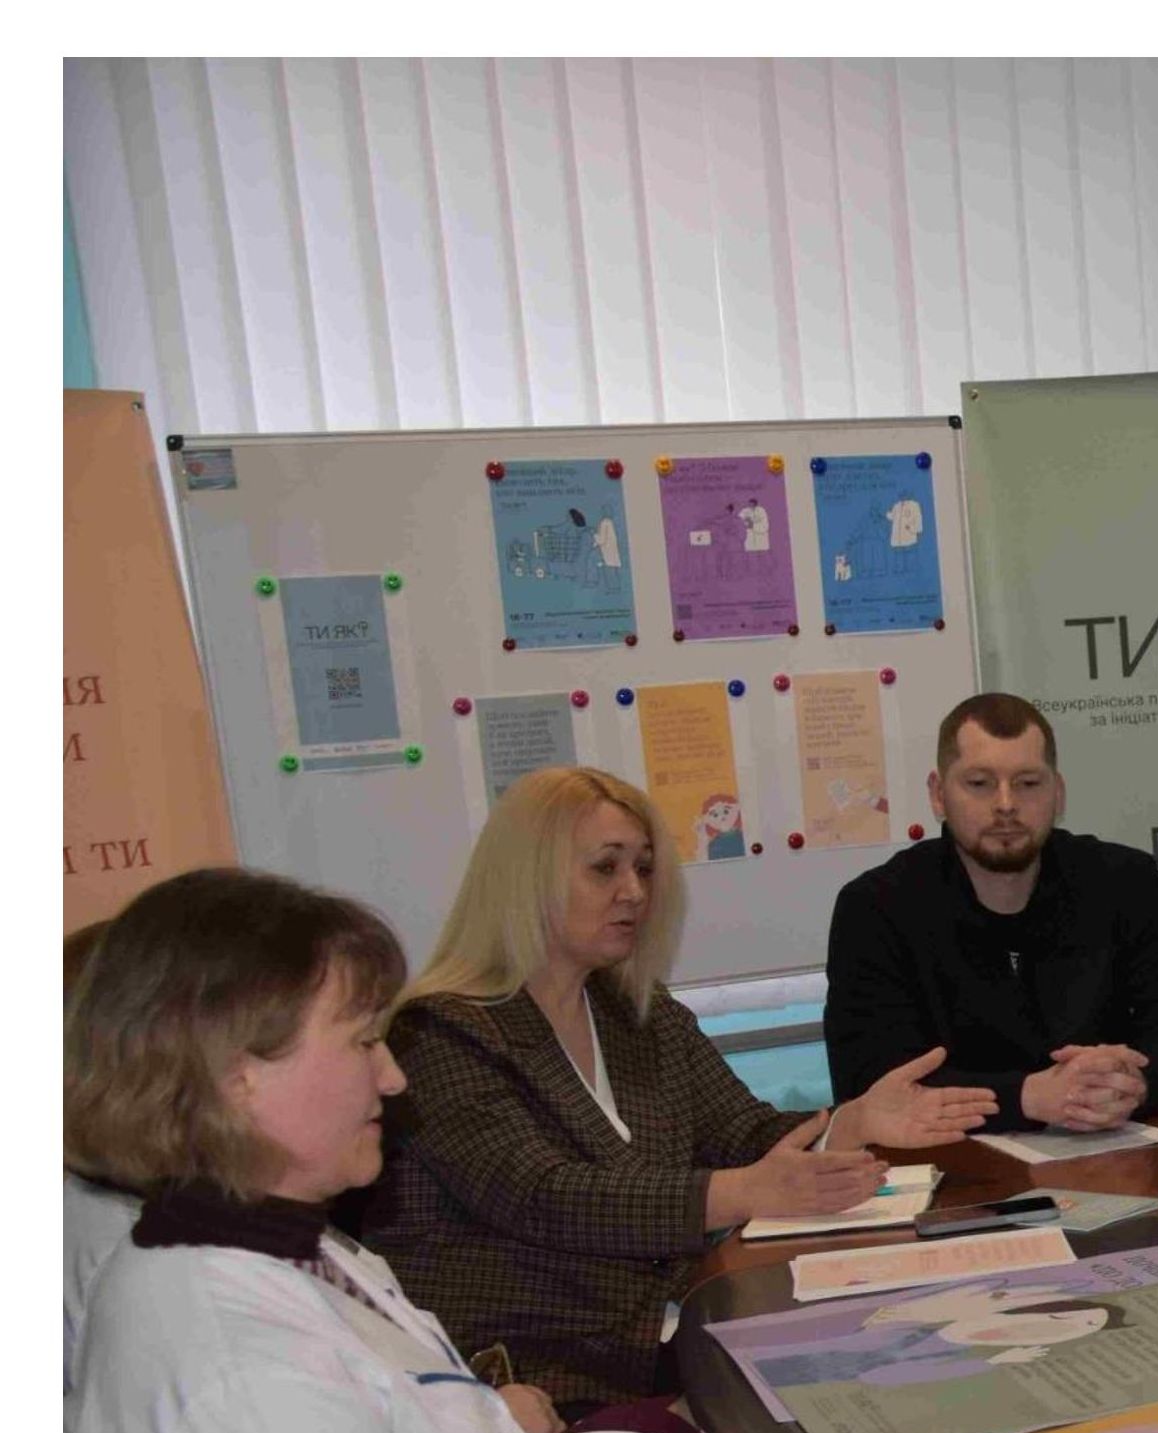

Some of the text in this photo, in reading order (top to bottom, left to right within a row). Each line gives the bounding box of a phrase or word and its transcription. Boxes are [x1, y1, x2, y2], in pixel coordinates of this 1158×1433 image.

[304, 624, 330, 641] ТИ
[1033, 693, 1145, 714] Всеукраїнська
[1089, 714, 1108, 727] за
[90, 838, 152, 873] ТИ
